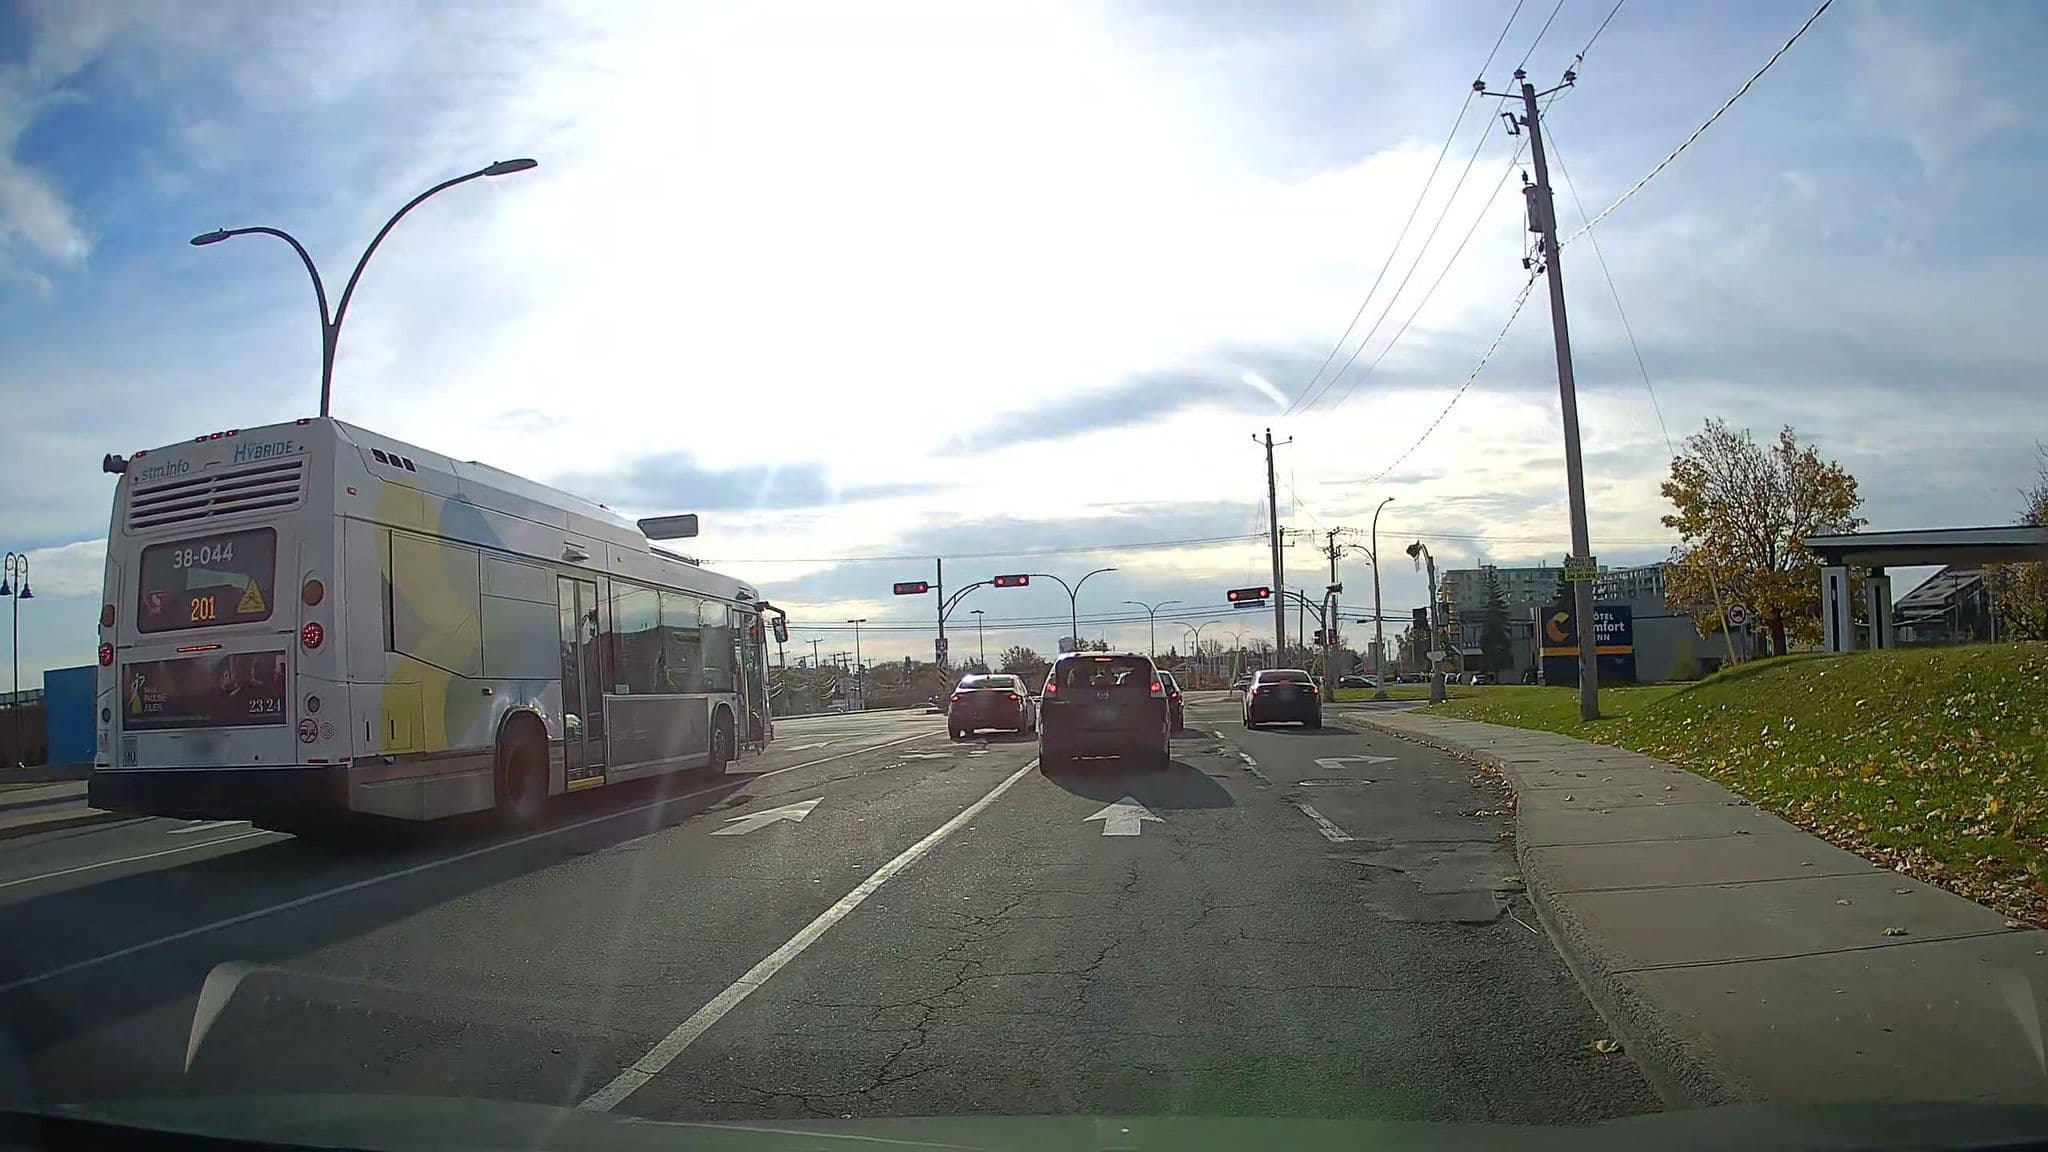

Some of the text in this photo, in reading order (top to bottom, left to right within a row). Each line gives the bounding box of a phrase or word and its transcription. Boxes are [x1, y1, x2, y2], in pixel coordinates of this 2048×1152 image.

[142, 458, 190, 481] stm.info
[173, 542, 234, 569] 38-044
[191, 595, 217, 621] 201
[1592, 610, 1614, 621] ÔTEL
[1592, 620, 1625, 632] mfort
